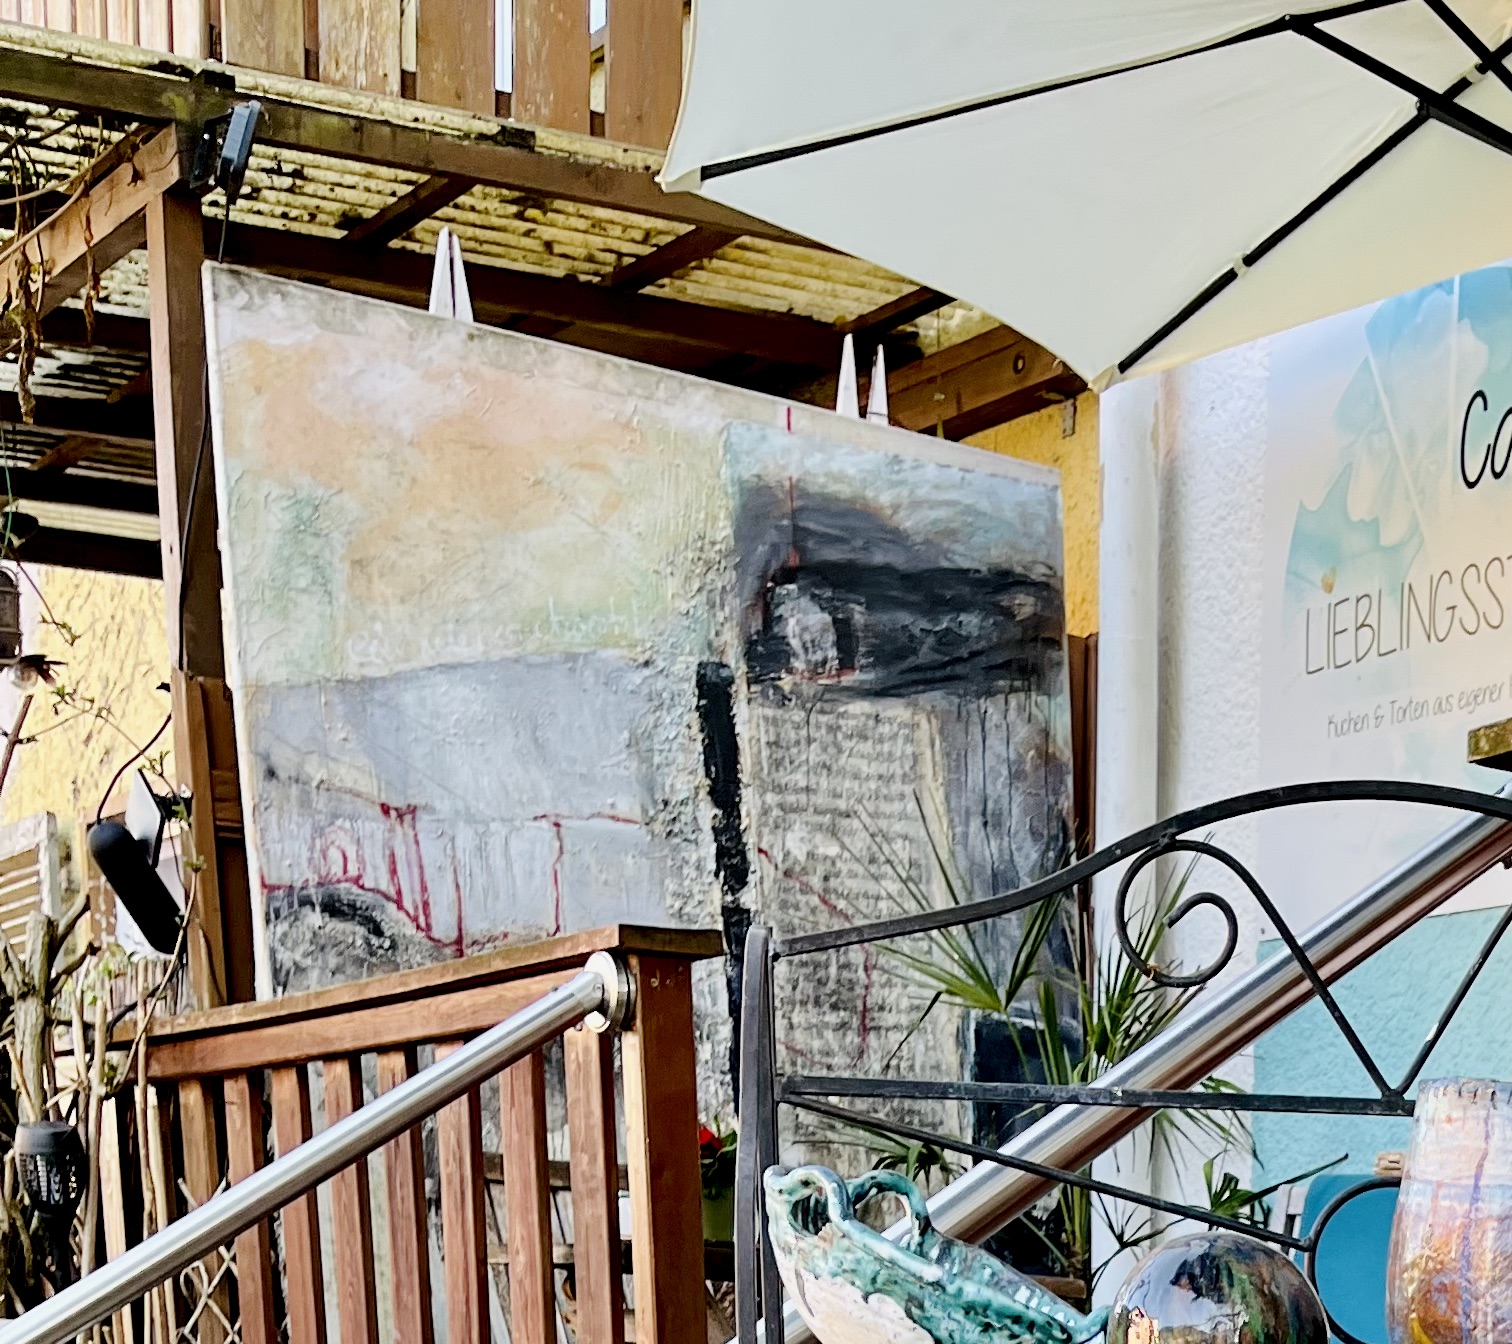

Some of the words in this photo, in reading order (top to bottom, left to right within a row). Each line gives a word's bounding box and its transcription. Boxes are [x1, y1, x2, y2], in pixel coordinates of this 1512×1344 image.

[1327, 710, 1369, 739] Kuchen
[1374, 705, 1385, 729] &
[1390, 697, 1430, 726] Torten
[1433, 694, 1454, 714] aus
[1457, 680, 1505, 715] eigener
